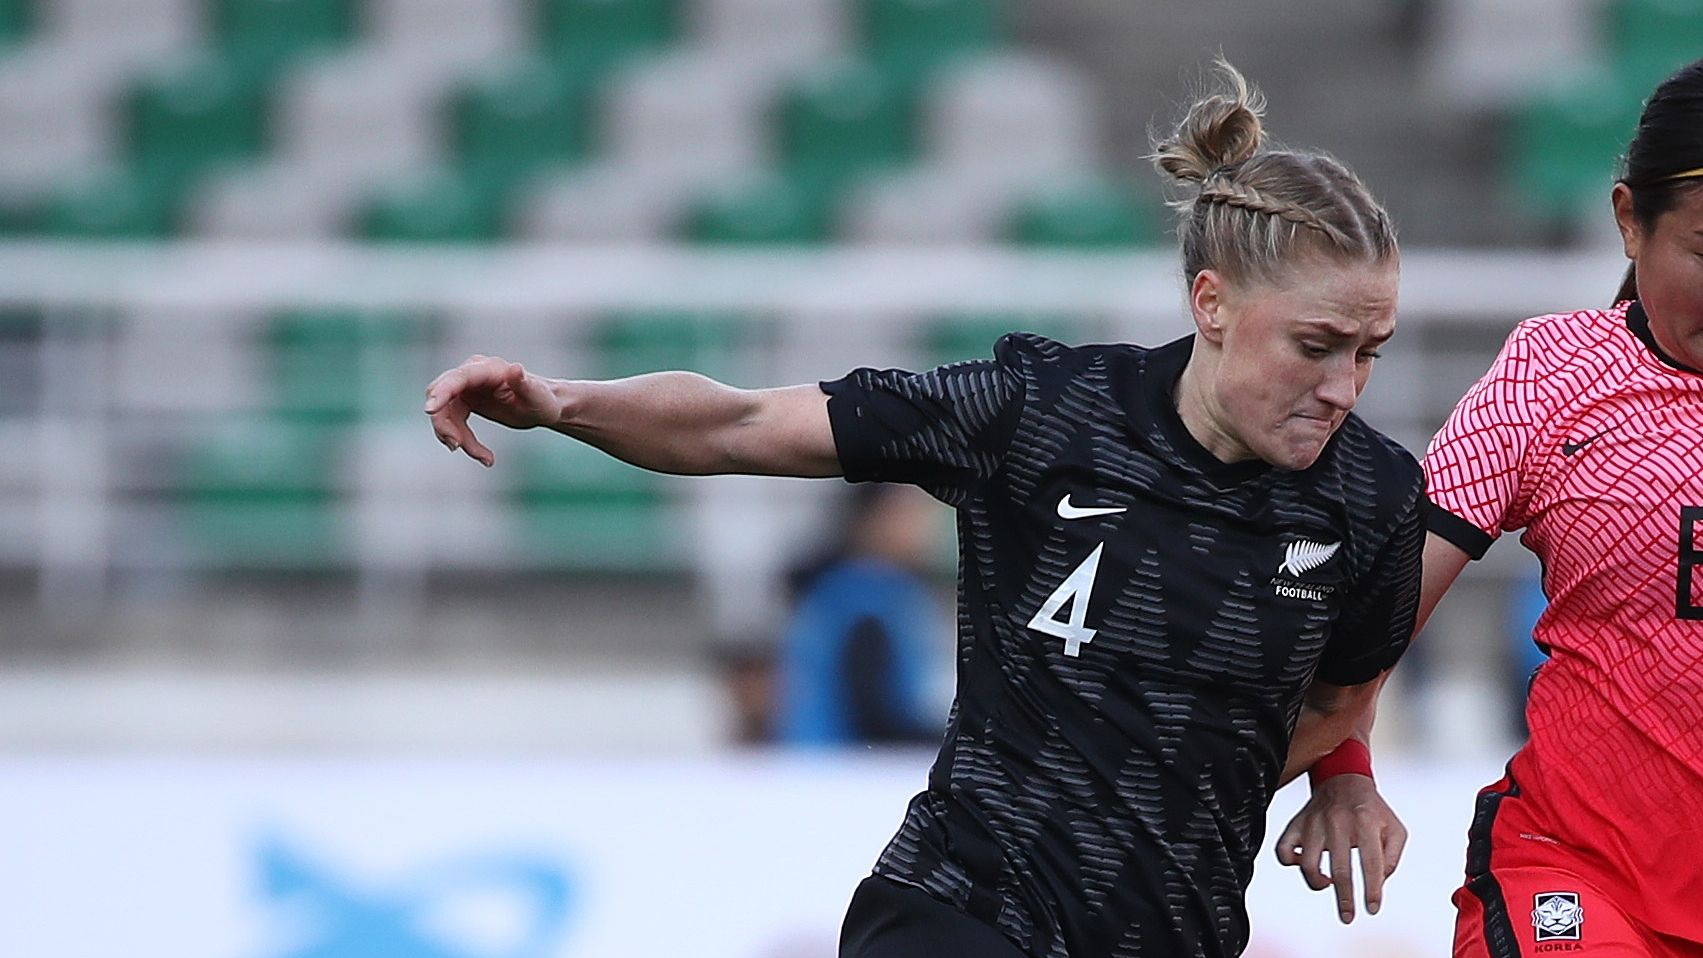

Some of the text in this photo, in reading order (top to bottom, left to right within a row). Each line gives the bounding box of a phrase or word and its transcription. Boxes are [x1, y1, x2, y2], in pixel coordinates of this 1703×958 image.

[1026, 541, 1104, 658] 4
[1275, 585, 1323, 601] FOOTBALL
[1534, 943, 1583, 953] KOREA
